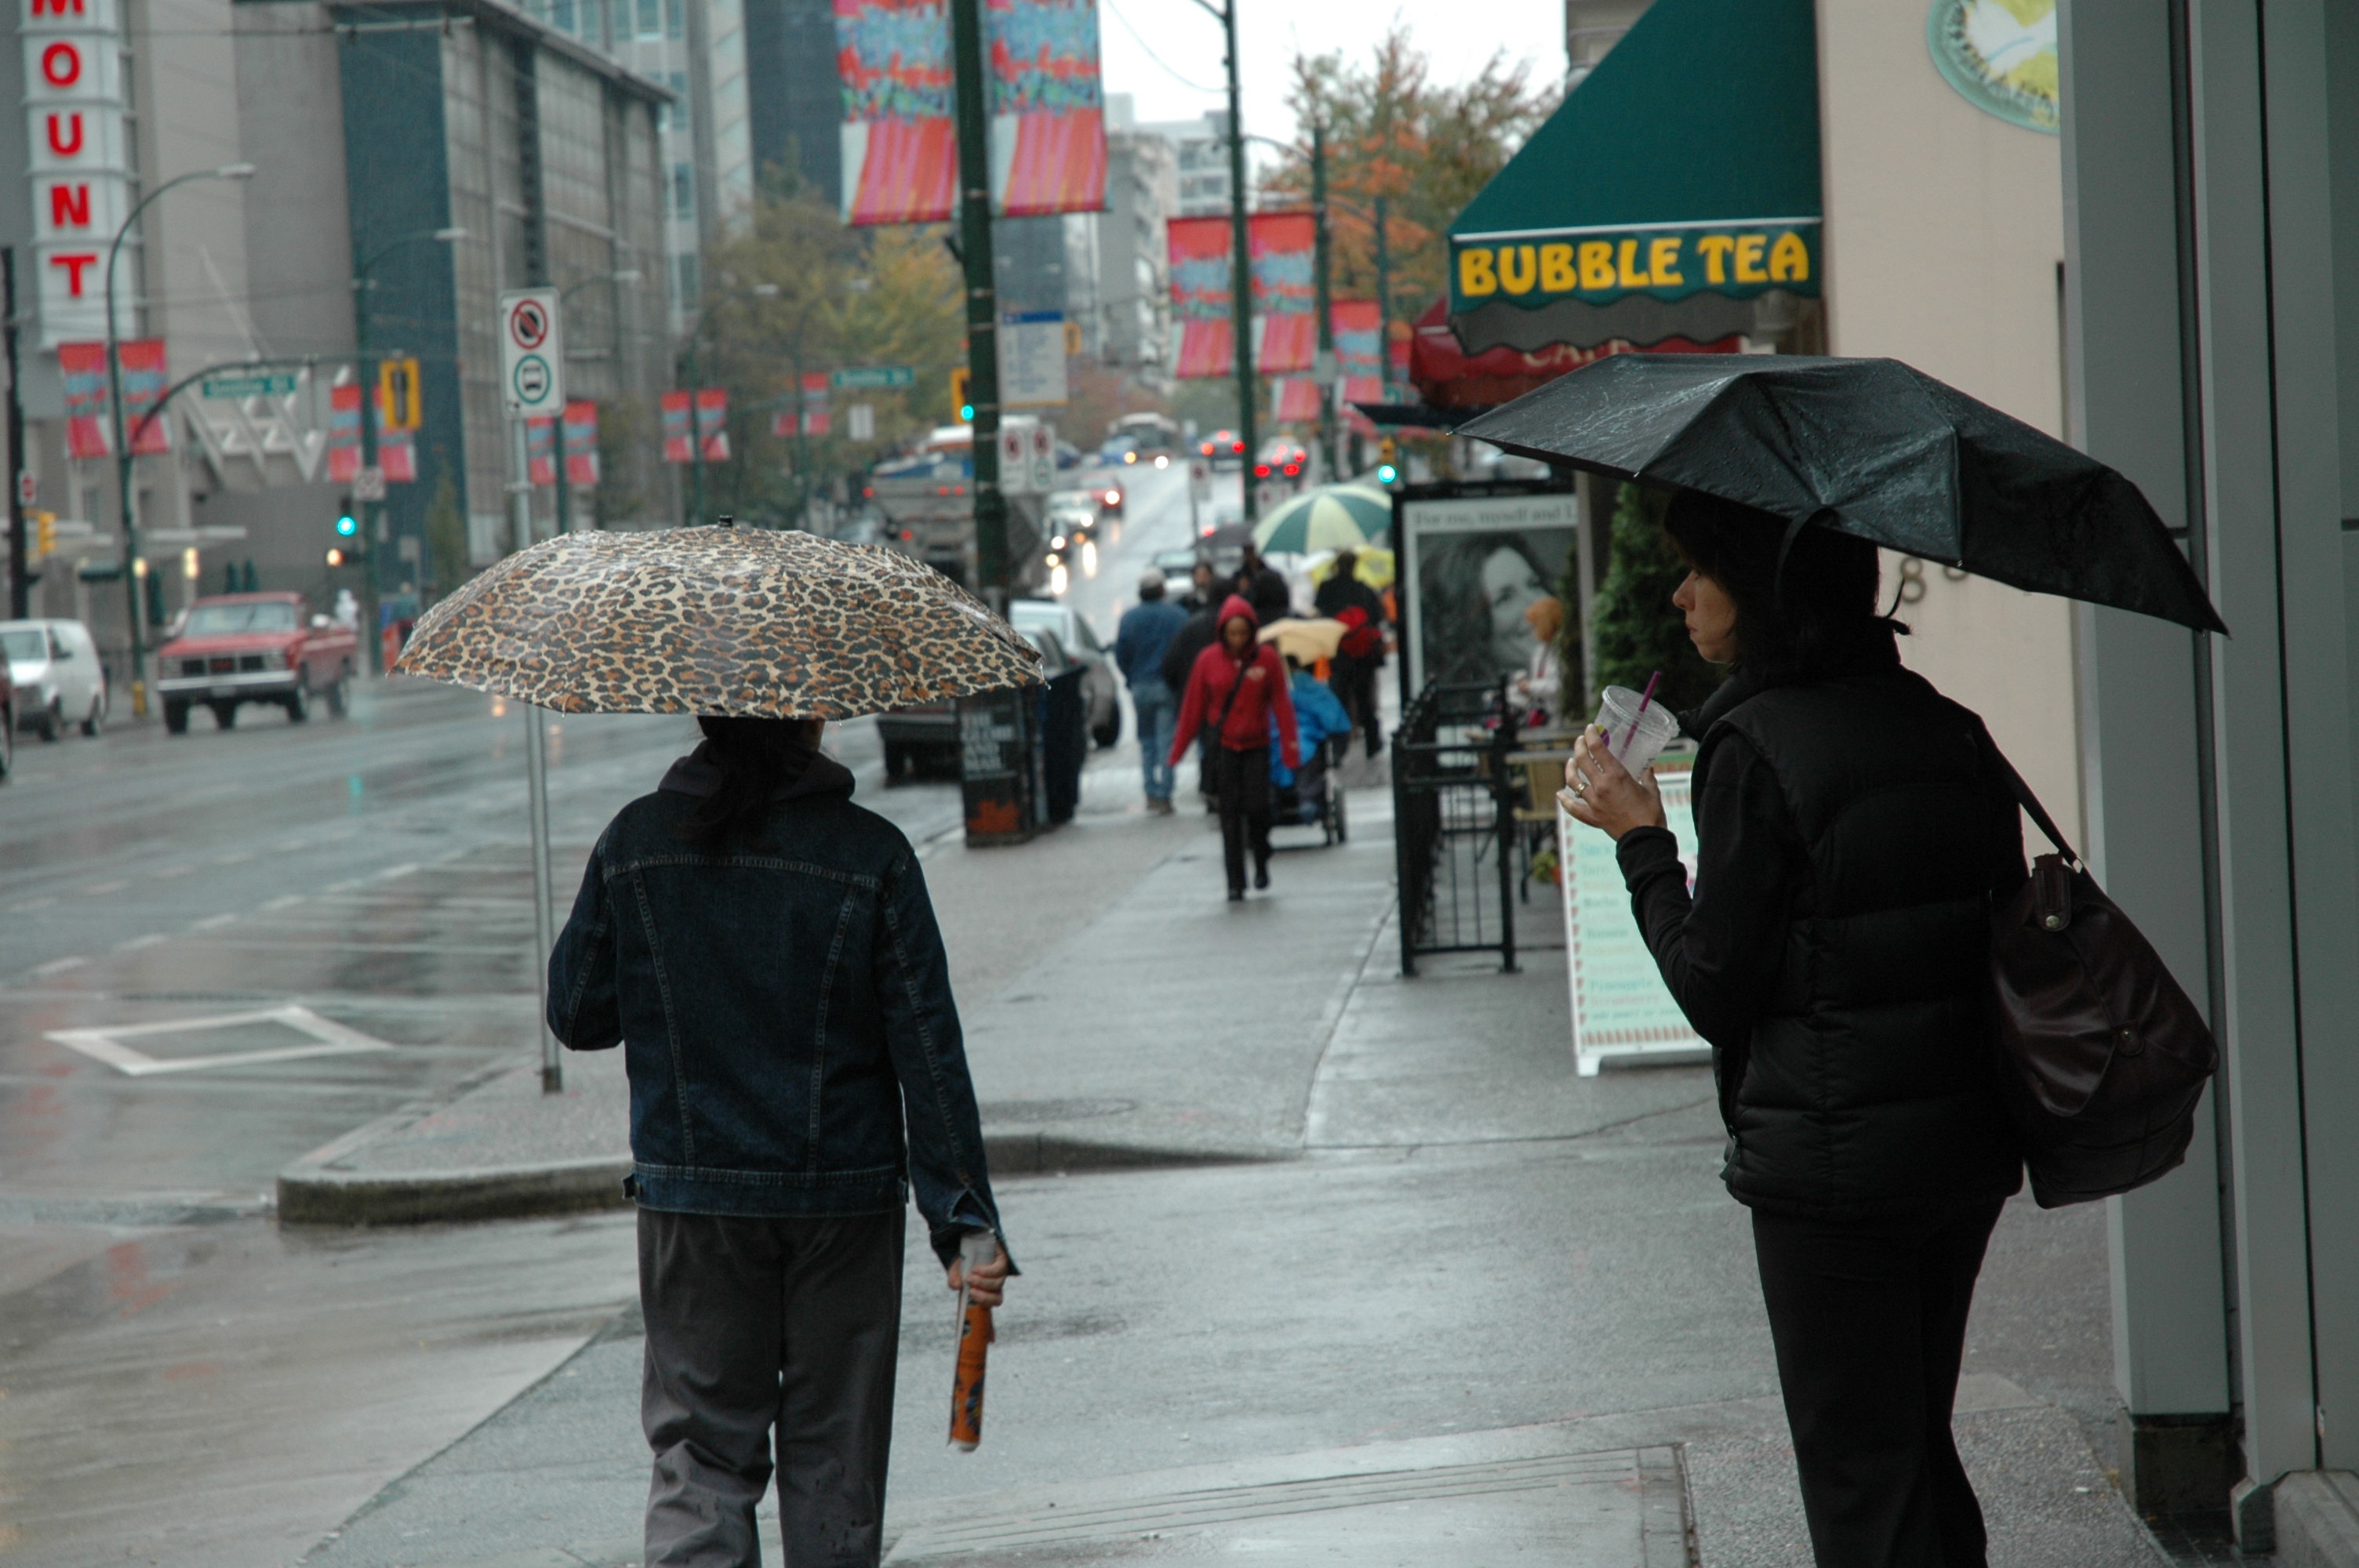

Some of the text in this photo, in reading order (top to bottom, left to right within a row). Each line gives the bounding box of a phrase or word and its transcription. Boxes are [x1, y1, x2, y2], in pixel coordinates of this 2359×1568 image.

[1459, 232, 1809, 297] BUBBLE TEA
[1522, 338, 1633, 367] CAE
[1416, 513, 1441, 524] For
[1479, 508, 1528, 528] myself
[1532, 505, 1561, 521] and
[1590, 978, 1654, 991] Pineapple
[1590, 994, 1659, 1007] Strawberry
